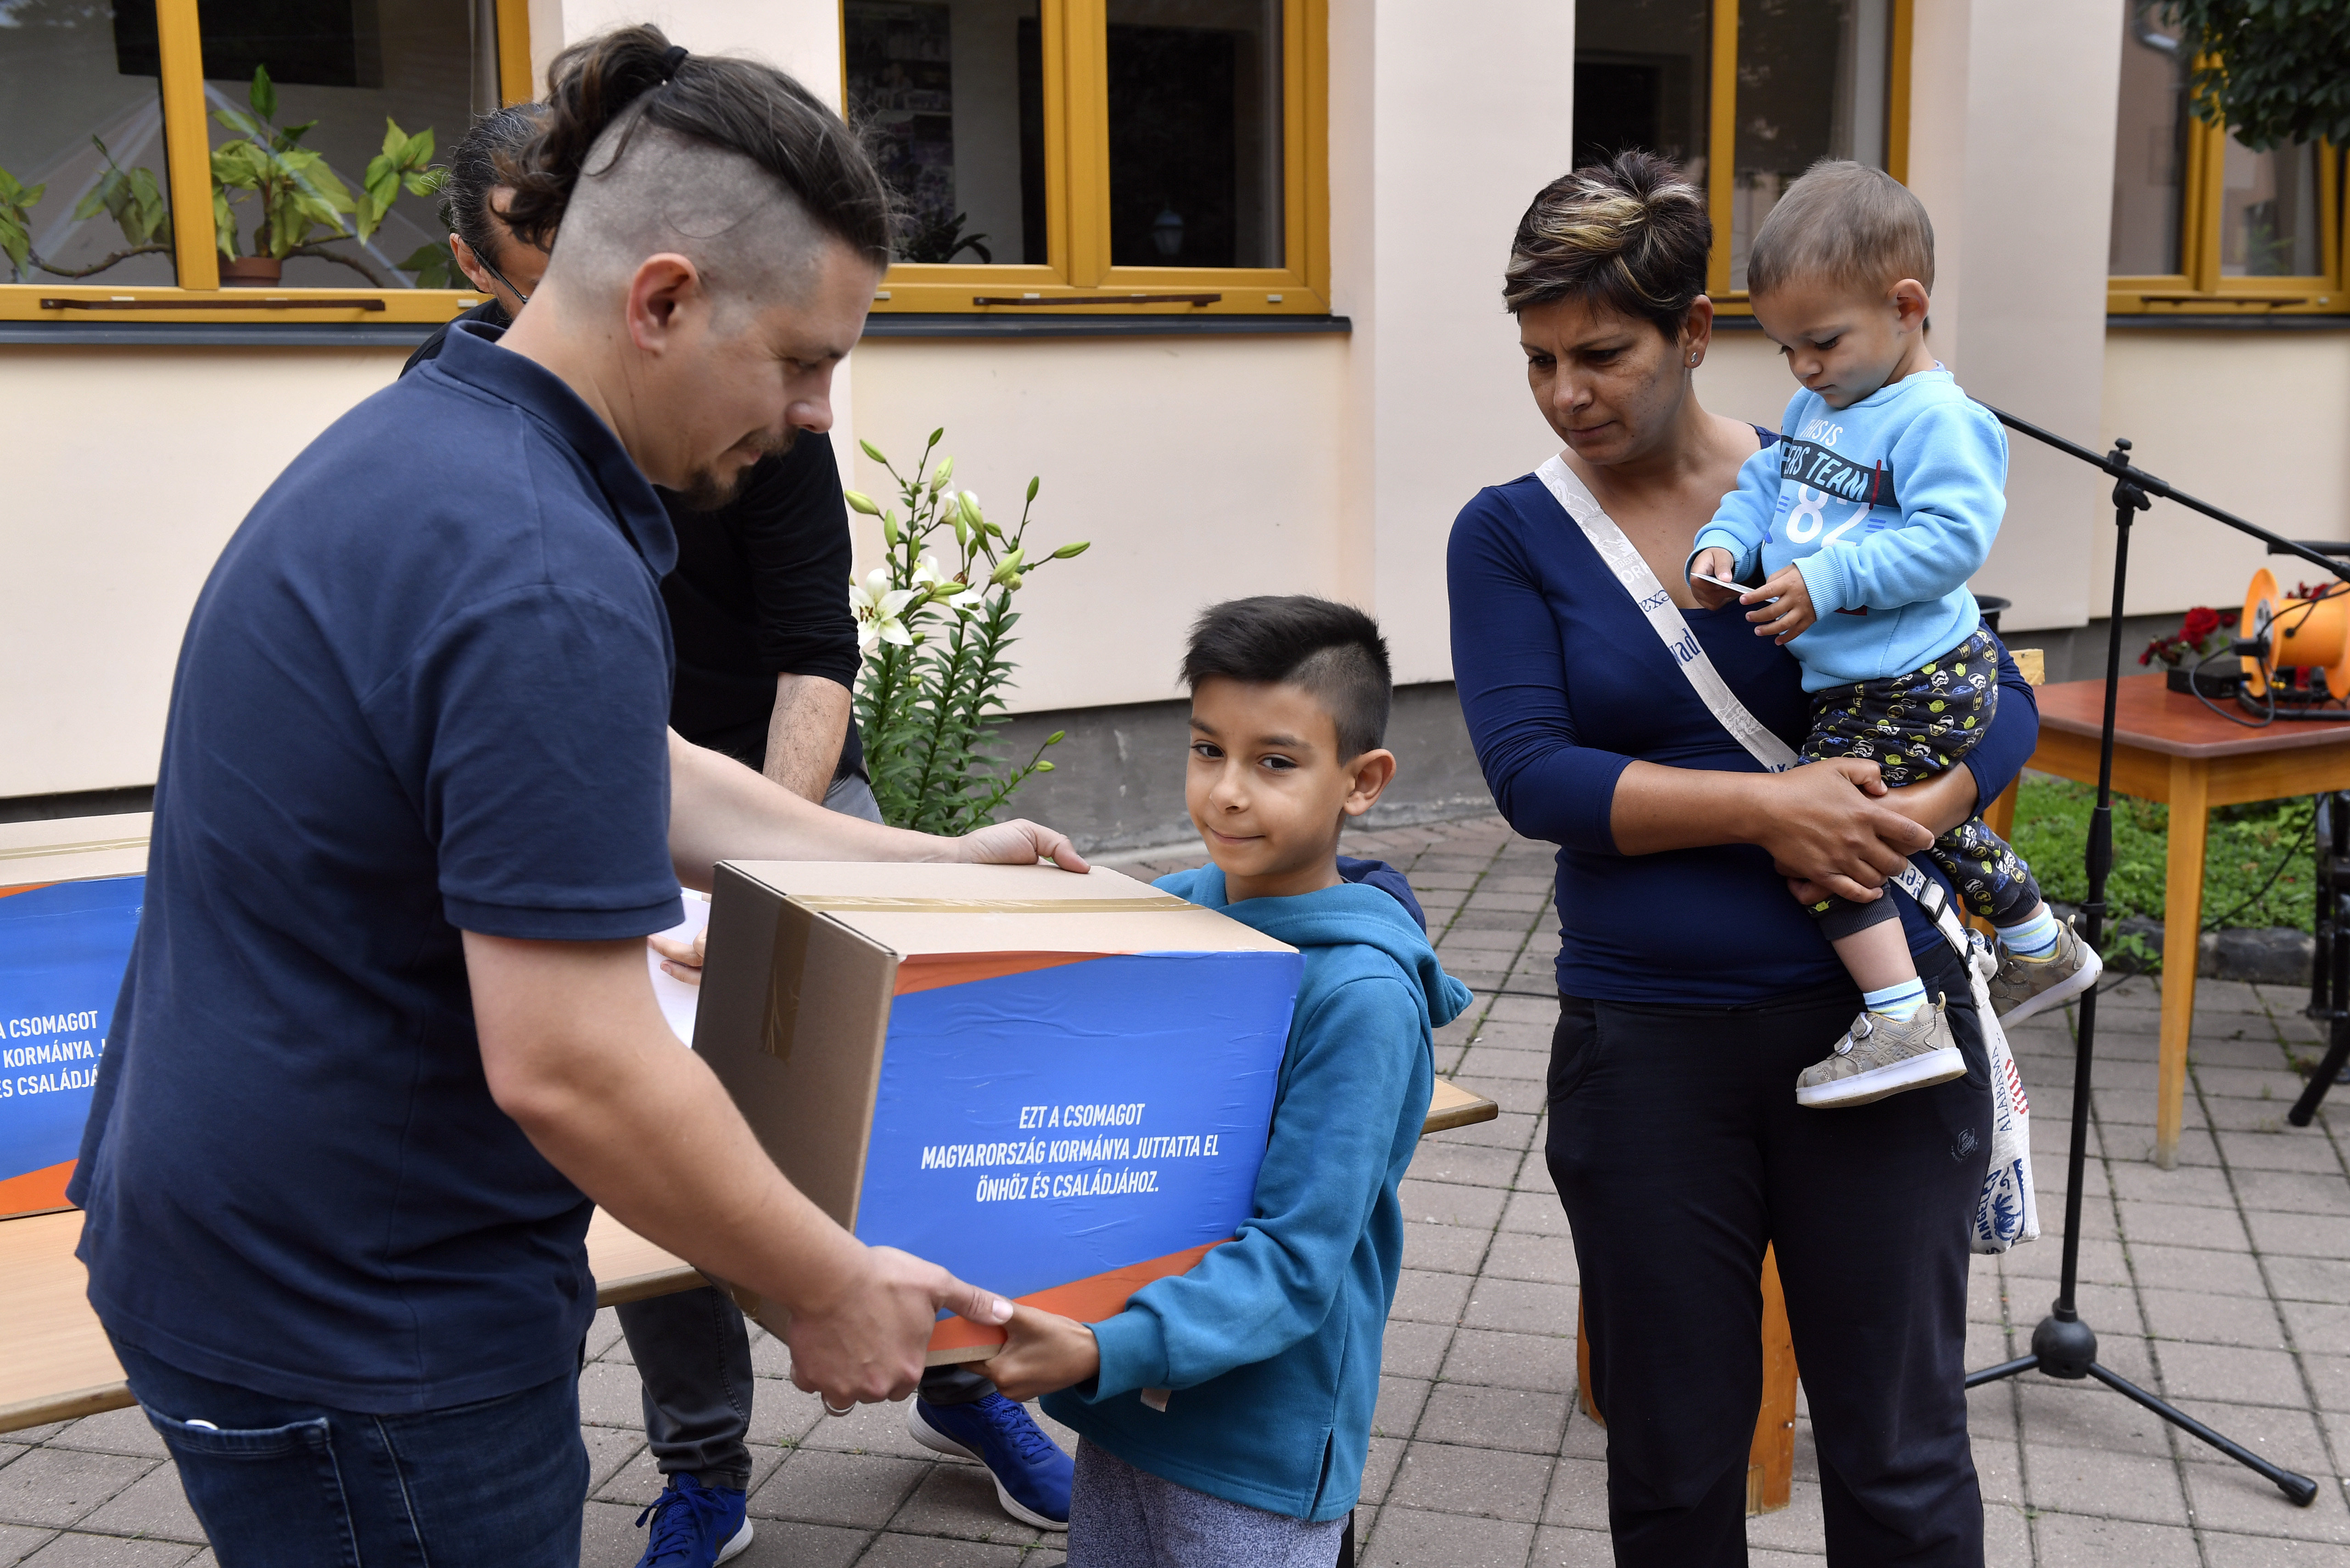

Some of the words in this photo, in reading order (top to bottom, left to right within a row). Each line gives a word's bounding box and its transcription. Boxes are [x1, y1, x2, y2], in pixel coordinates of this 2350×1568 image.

[1799, 419, 1829, 439] THIS
[1819, 423, 1843, 447] IS
[1805, 451, 1869, 502] TEAM
[9, 1010, 98, 1038] CSOMAGOT
[3, 1039, 95, 1069] KORMÁNYA
[0, 1079, 13, 1098] S
[1992, 1045, 2013, 1131] ALABAMA
[1019, 1105, 1048, 1129] EZT
[1048, 1106, 1059, 1128] A
[1063, 1103, 1146, 1127] CSOMAGOT
[921, 1137, 1046, 1170] MAGYARORSZÁG
[1048, 1134, 1130, 1163] KORMÁNYA
[1132, 1136, 1200, 1159] JUTTATTA
[1203, 1134, 1219, 1156] EL
[976, 1174, 1028, 1203] ÖNHÖZ
[1030, 1172, 1050, 1199] ÉS
[1053, 1170, 1159, 1197] CSALÁDJÁHOZ.
